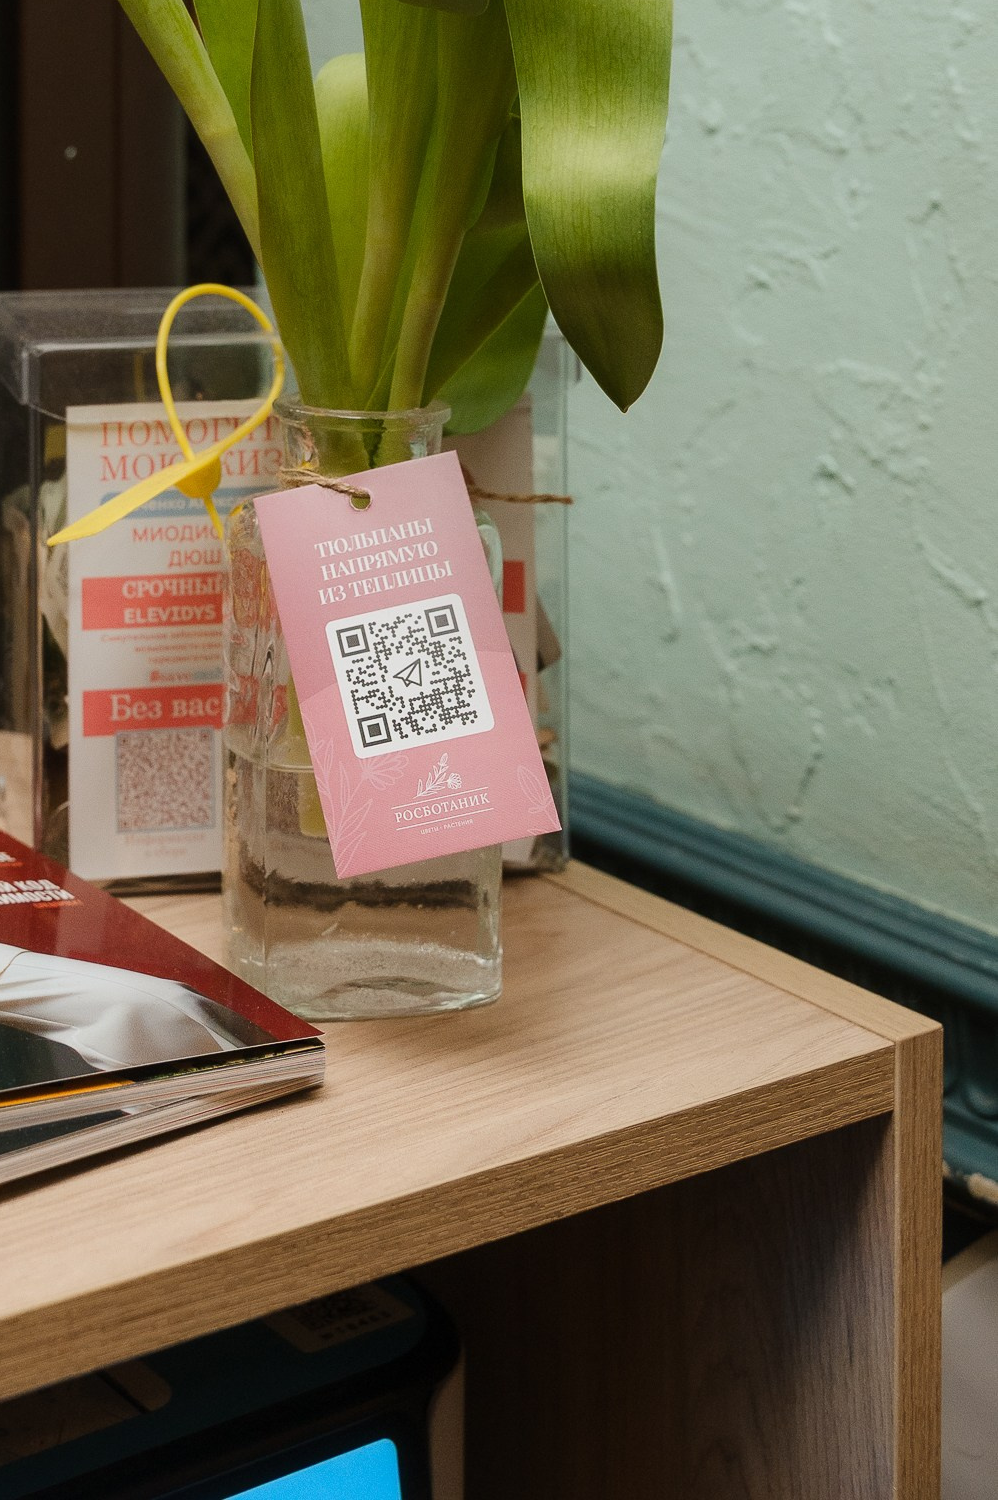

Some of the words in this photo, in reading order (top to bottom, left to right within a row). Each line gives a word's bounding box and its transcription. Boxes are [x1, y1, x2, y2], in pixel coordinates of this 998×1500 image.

[314, 517, 435, 558] ТЮЛЬПАНЫ
[320, 540, 439, 581] НАПРЯМУЮ
[318, 585, 347, 605] ИЗ
[348, 560, 454, 598] ТЕПЛИЦЫ
[123, 603, 217, 624] ELEVIDYS
[110, 693, 162, 722] Без
[171, 696, 221, 719] вас
[394, 792, 490, 823] РОСБОТАНИК
[420, 826, 440, 835] ЦВЕТЫ
[443, 818, 474, 830] РАСТЕНИЯ
[13, 878, 61, 891] КОД
